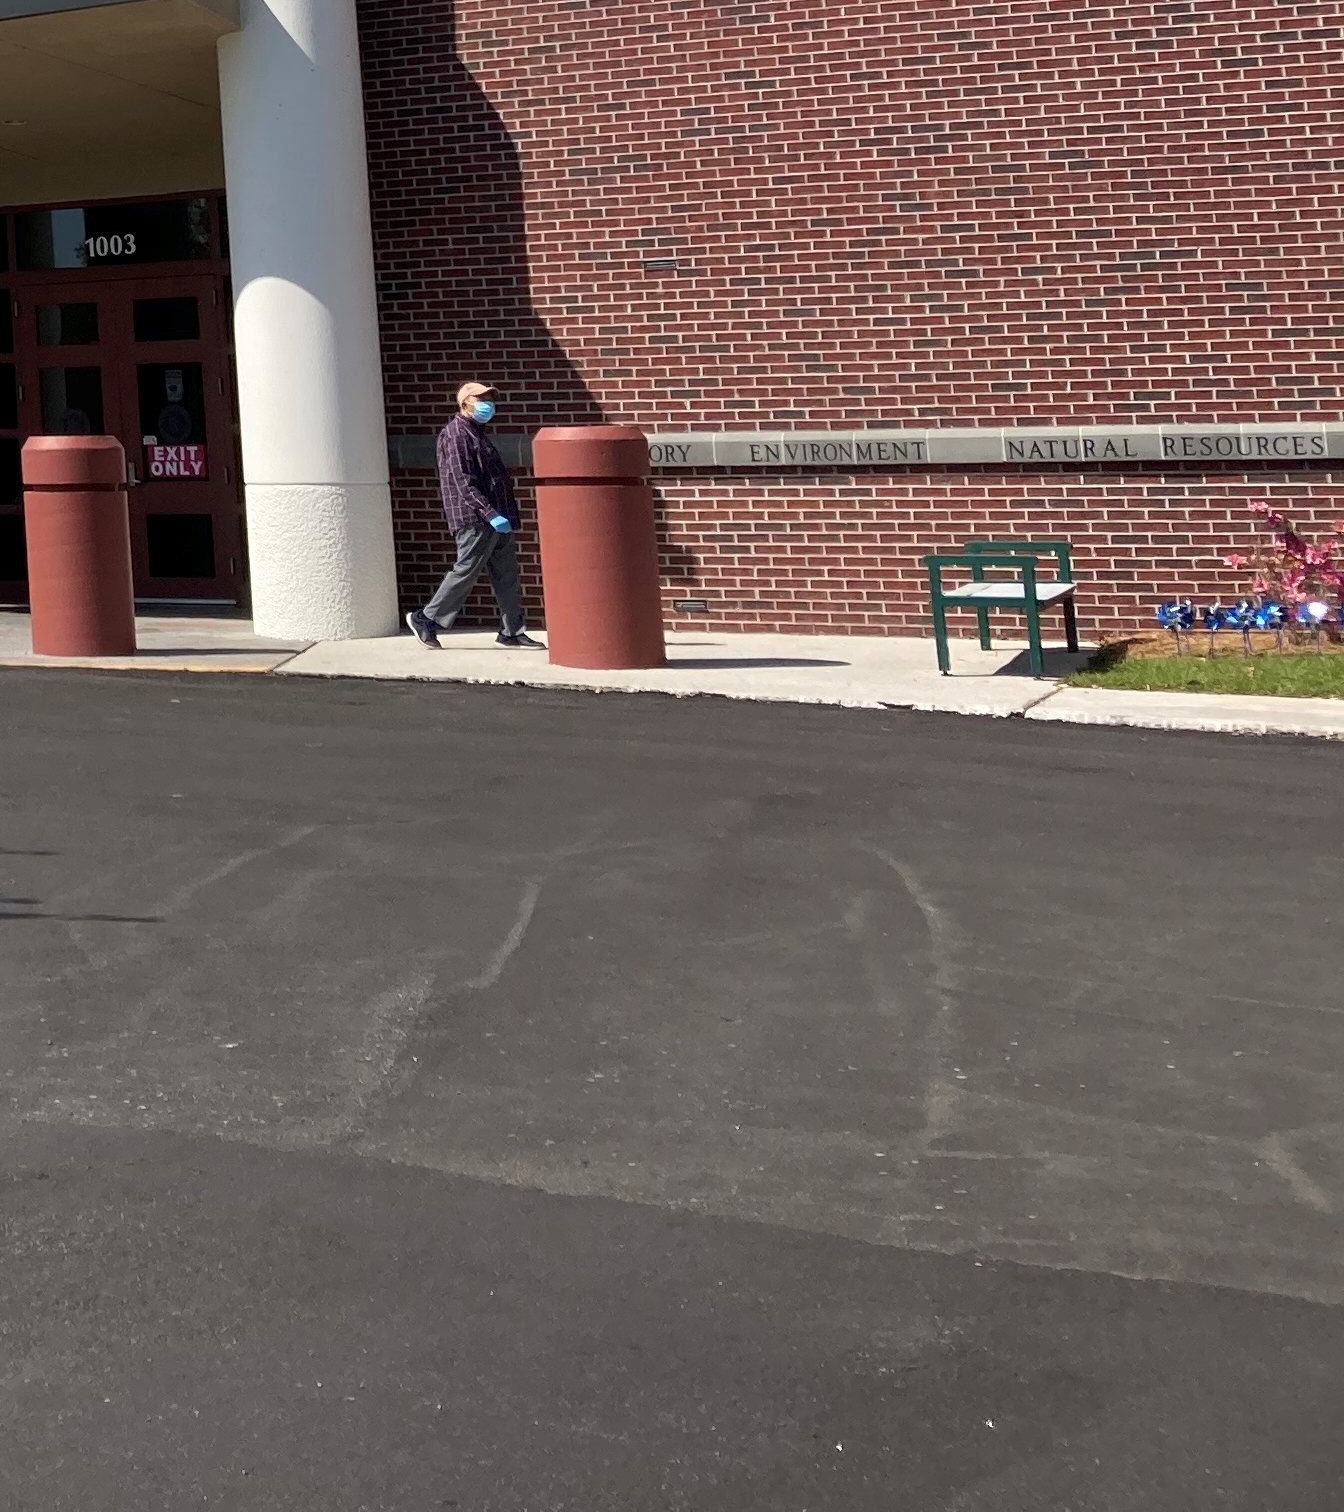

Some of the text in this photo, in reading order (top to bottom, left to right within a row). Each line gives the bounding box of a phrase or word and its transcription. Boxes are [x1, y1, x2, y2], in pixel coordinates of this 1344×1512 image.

[85, 233, 137, 257] 1003
[154, 445, 199, 461] EXIT
[648, 444, 692, 463] ORY
[750, 440, 926, 463] ENVIRONMENT
[1007, 435, 1326, 460] NATURAL RESOURCES
[150, 460, 204, 477] ONLY
